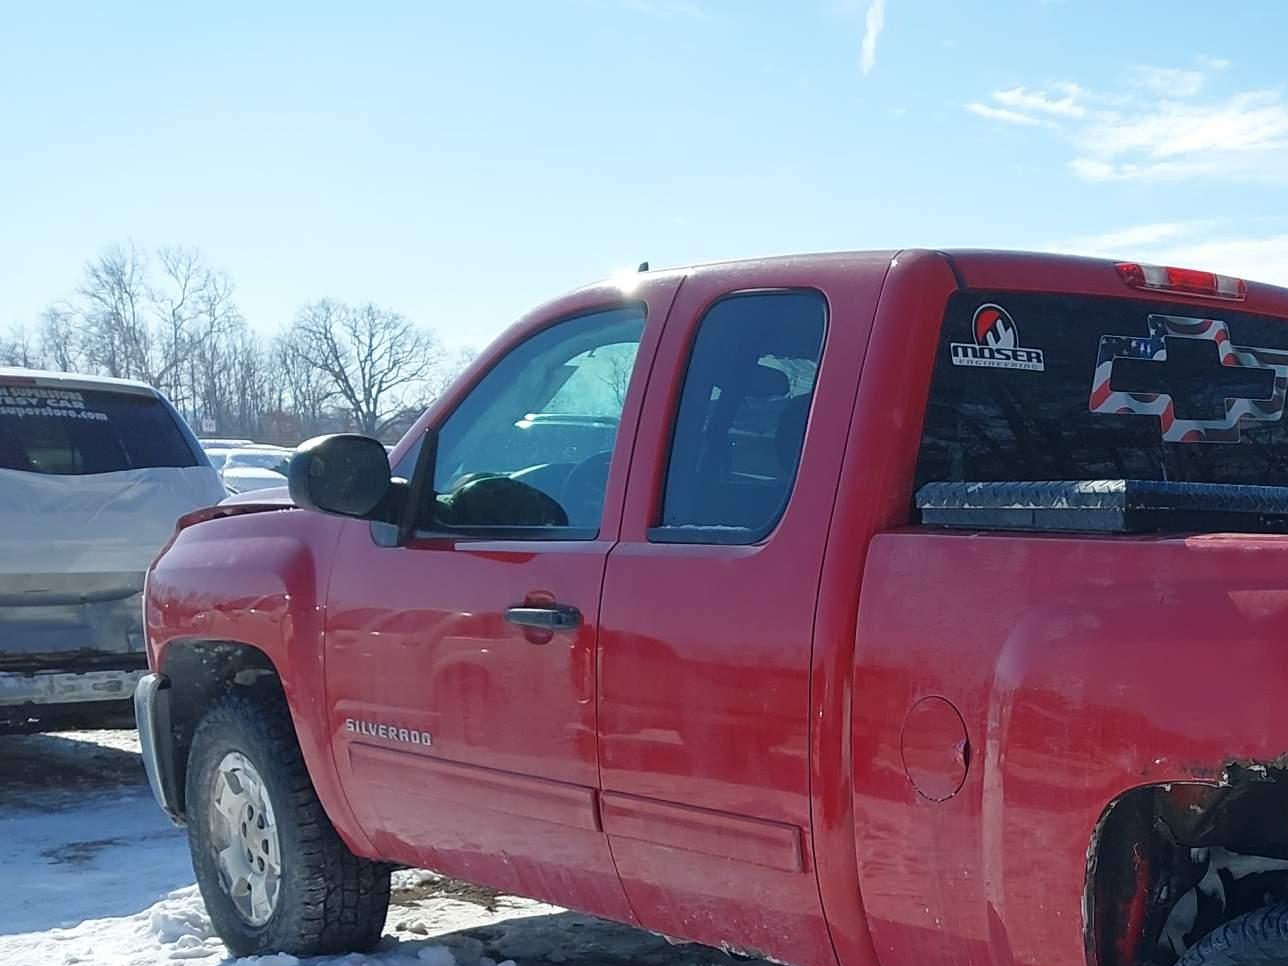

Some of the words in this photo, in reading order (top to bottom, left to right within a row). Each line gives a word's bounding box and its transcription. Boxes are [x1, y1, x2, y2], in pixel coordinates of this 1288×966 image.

[952, 345, 1042, 363] MOSER
[46, 398, 85, 409] CAR
[345, 718, 432, 746] SILVERADO
